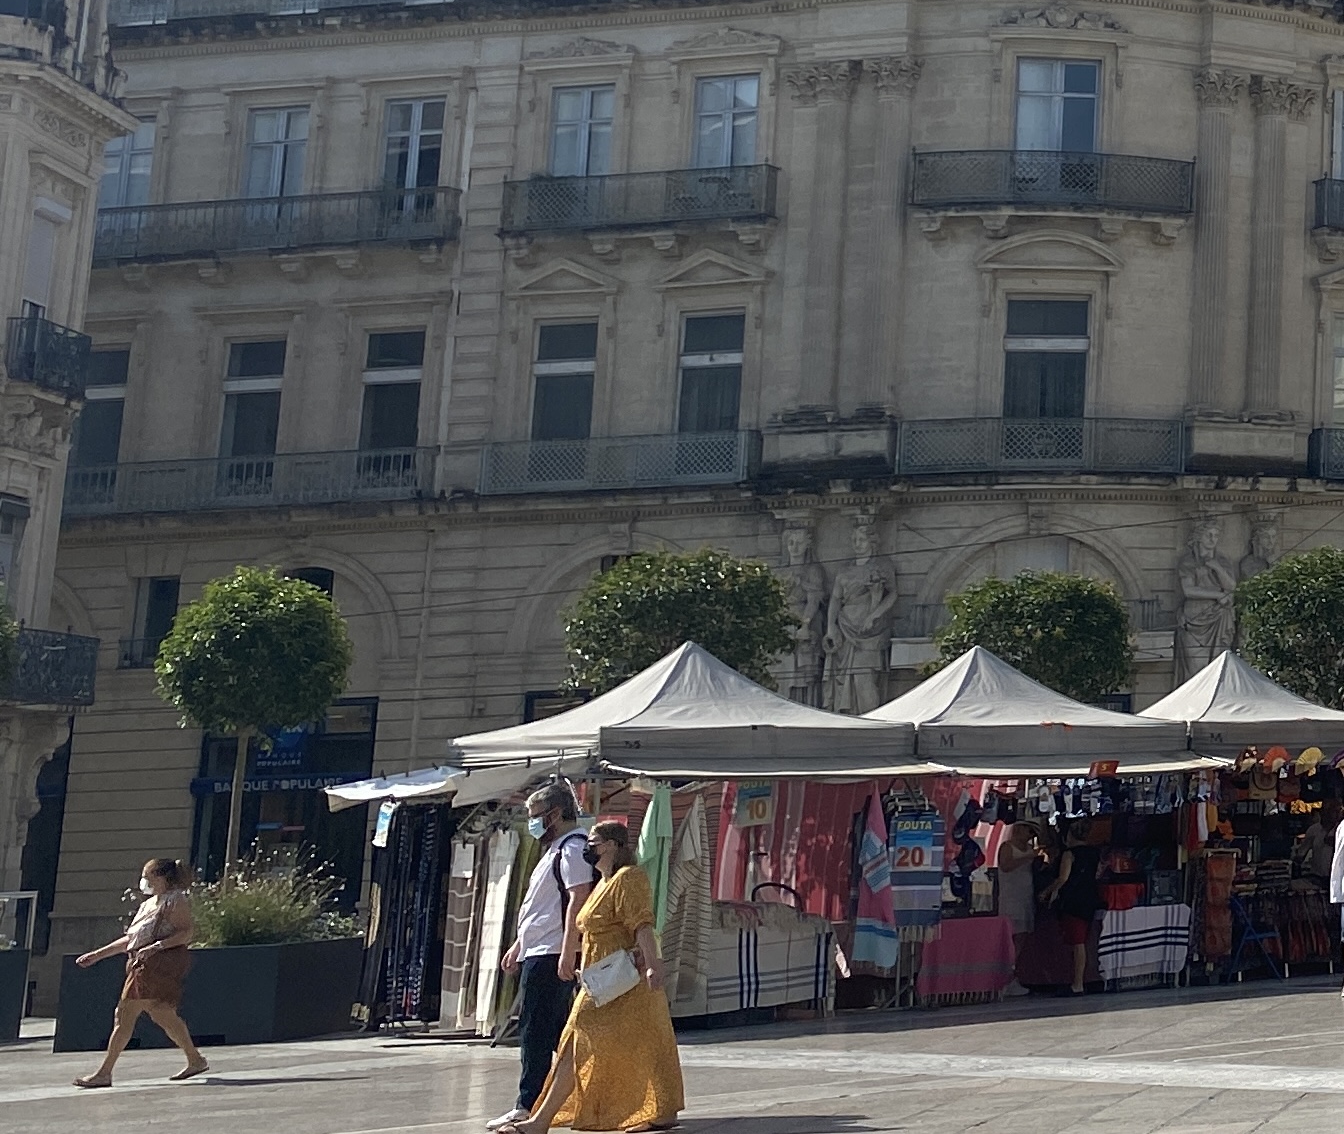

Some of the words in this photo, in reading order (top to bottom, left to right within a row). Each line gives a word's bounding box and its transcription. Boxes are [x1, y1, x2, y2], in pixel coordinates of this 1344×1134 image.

[213, 779, 269, 793] BAQUE
[746, 799, 767, 820] 10
[898, 820, 933, 831] FOUTA
[896, 846, 924, 867] 20
